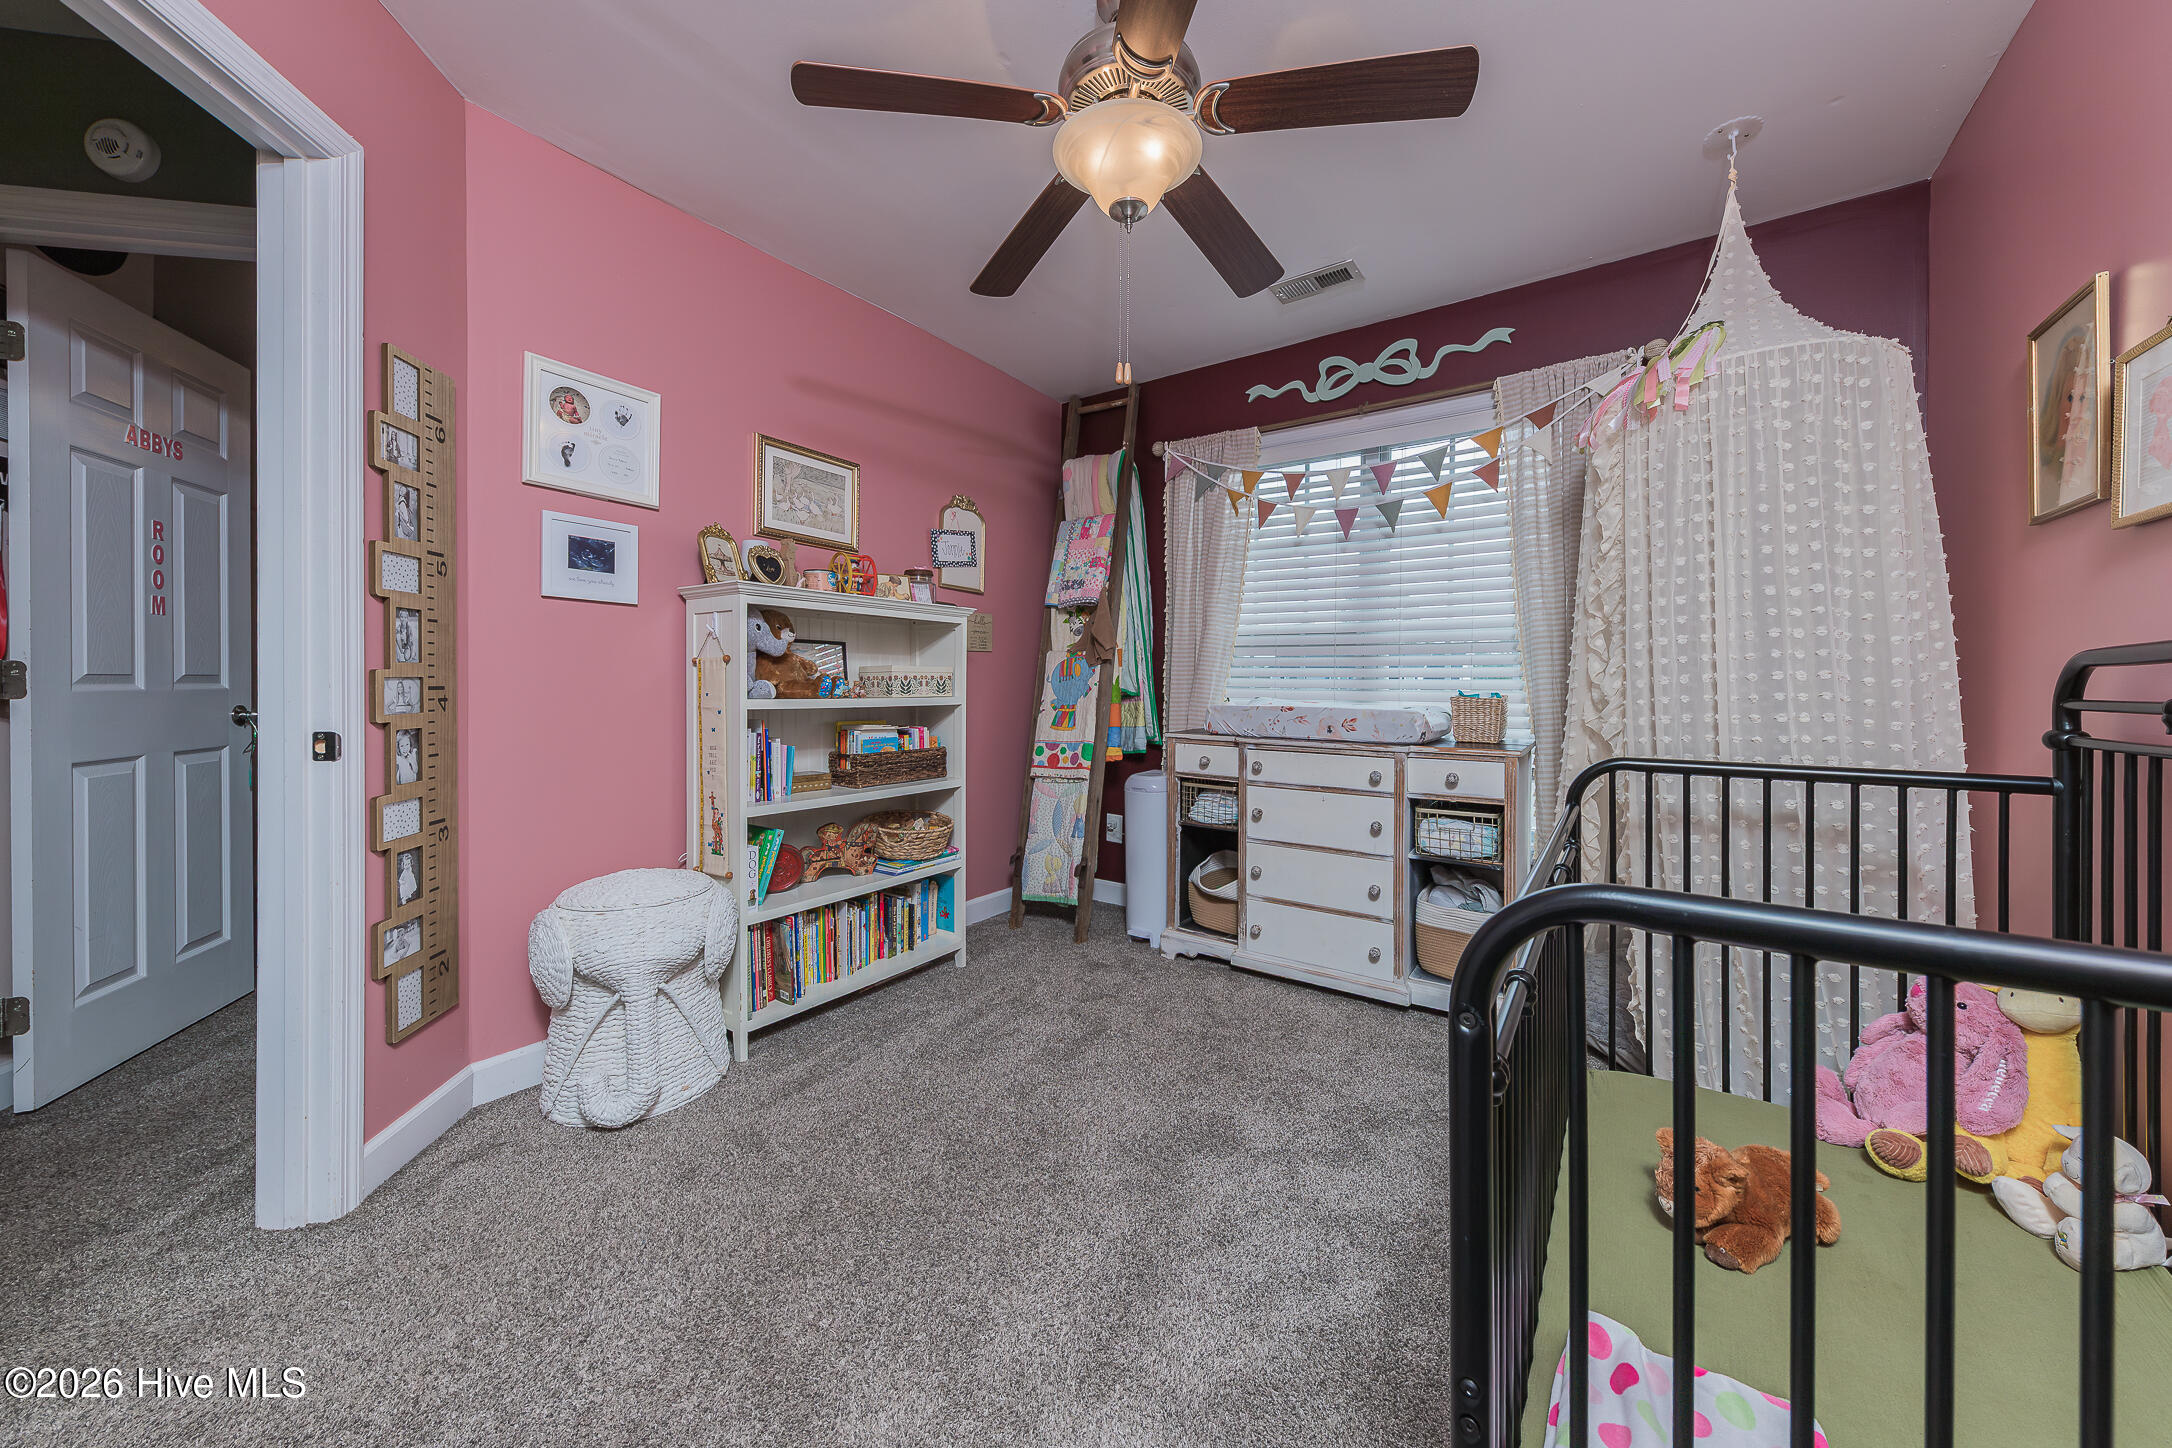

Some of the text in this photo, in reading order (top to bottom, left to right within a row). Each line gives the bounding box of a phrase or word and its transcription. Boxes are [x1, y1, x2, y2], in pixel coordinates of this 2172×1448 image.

[124, 424, 184, 461] ABBYS
[435, 425, 446, 444] 6
[151, 519, 166, 616] ROOM
[437, 560, 448, 577] 5
[438, 695, 448, 712] 4
[438, 826, 449, 842] 3
[748, 850, 757, 879] DOG
[438, 956, 450, 976] 2
